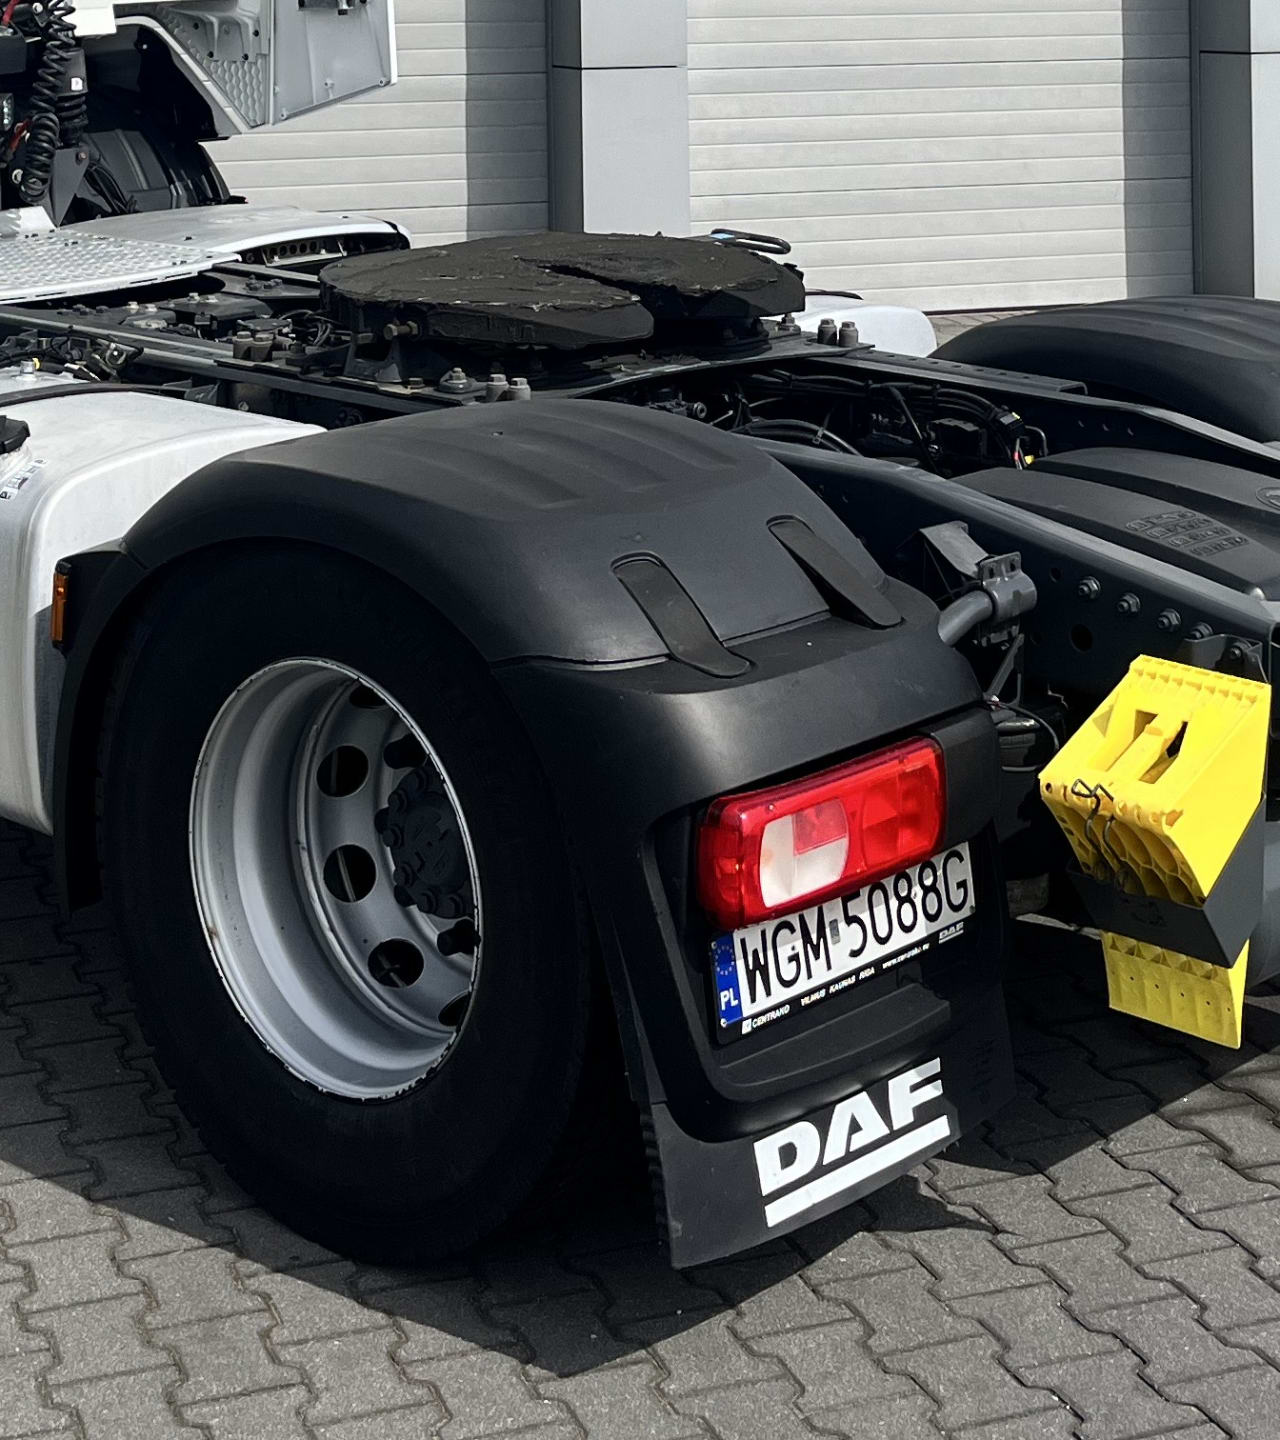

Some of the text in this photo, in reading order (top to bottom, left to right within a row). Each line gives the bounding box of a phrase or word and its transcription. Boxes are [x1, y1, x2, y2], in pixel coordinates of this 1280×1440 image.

[740, 849, 969, 1005] WGM 5088G
[939, 922, 964, 941] DAF
[719, 988, 739, 1011] PL
[753, 1057, 944, 1198] DAF
